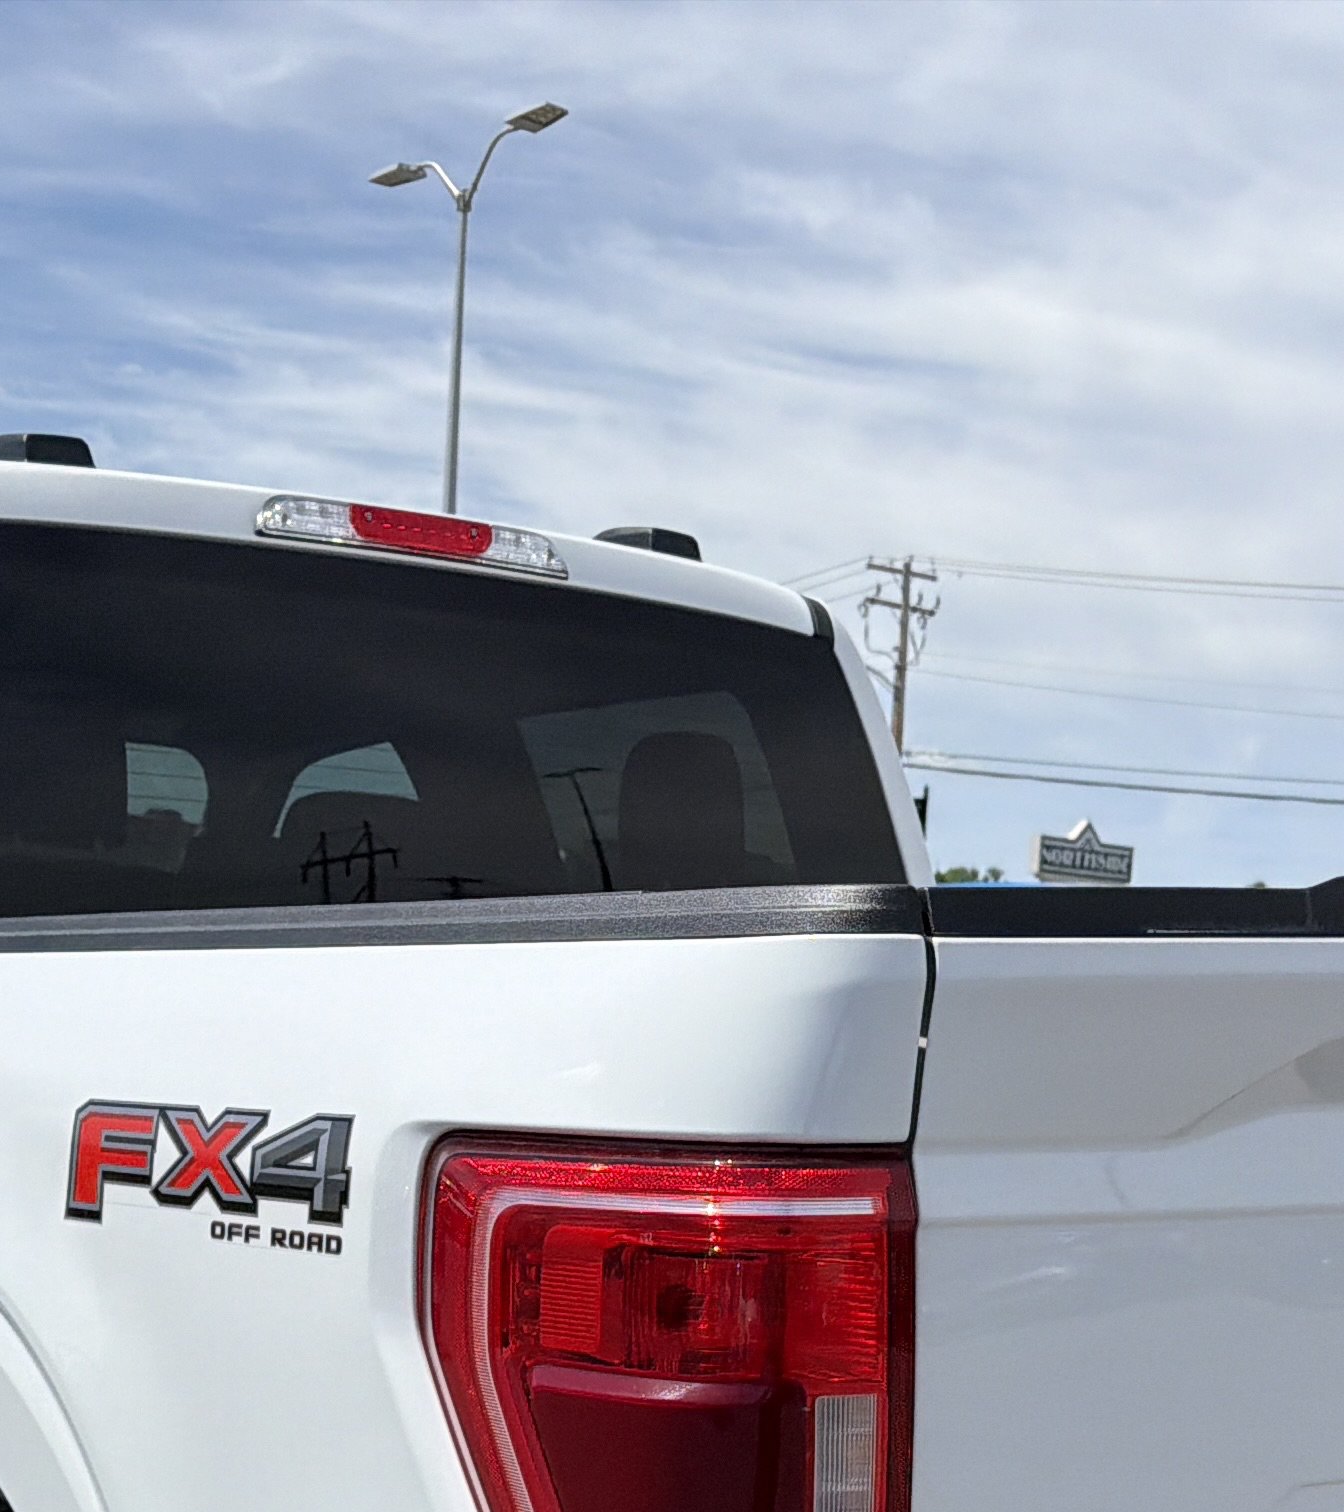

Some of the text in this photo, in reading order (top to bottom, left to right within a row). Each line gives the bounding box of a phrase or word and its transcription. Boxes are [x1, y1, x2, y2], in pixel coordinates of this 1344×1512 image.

[64, 1098, 356, 1228] FX4
[210, 1219, 343, 1256] OFF ROAD
